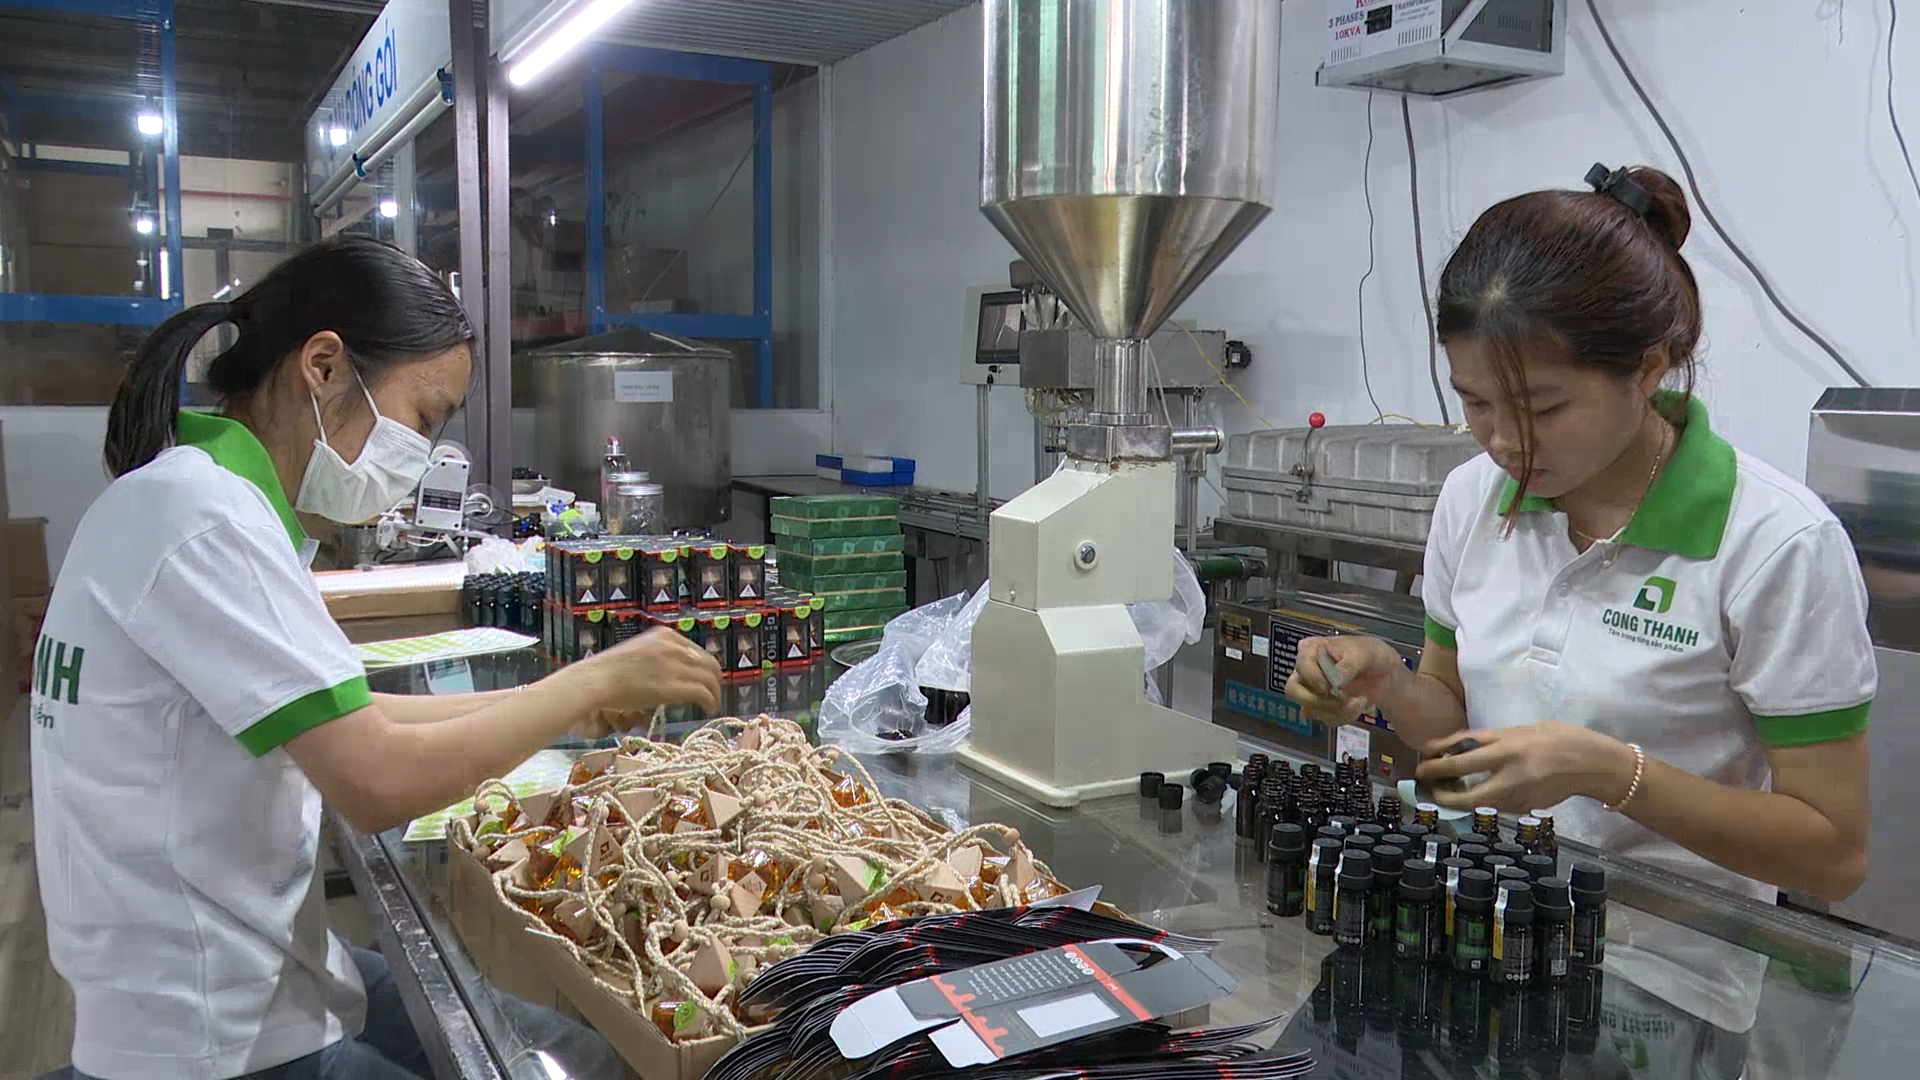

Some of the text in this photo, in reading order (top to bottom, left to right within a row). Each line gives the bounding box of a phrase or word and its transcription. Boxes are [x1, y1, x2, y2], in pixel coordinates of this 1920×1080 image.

[1328, 10, 1365, 29] 3 PHASES
[1335, 25, 1361, 41] 10KVA
[376, 19, 397, 107] GÓI
[1643, 618, 1699, 647] THANH
[766, 633, 777, 661] Oils
